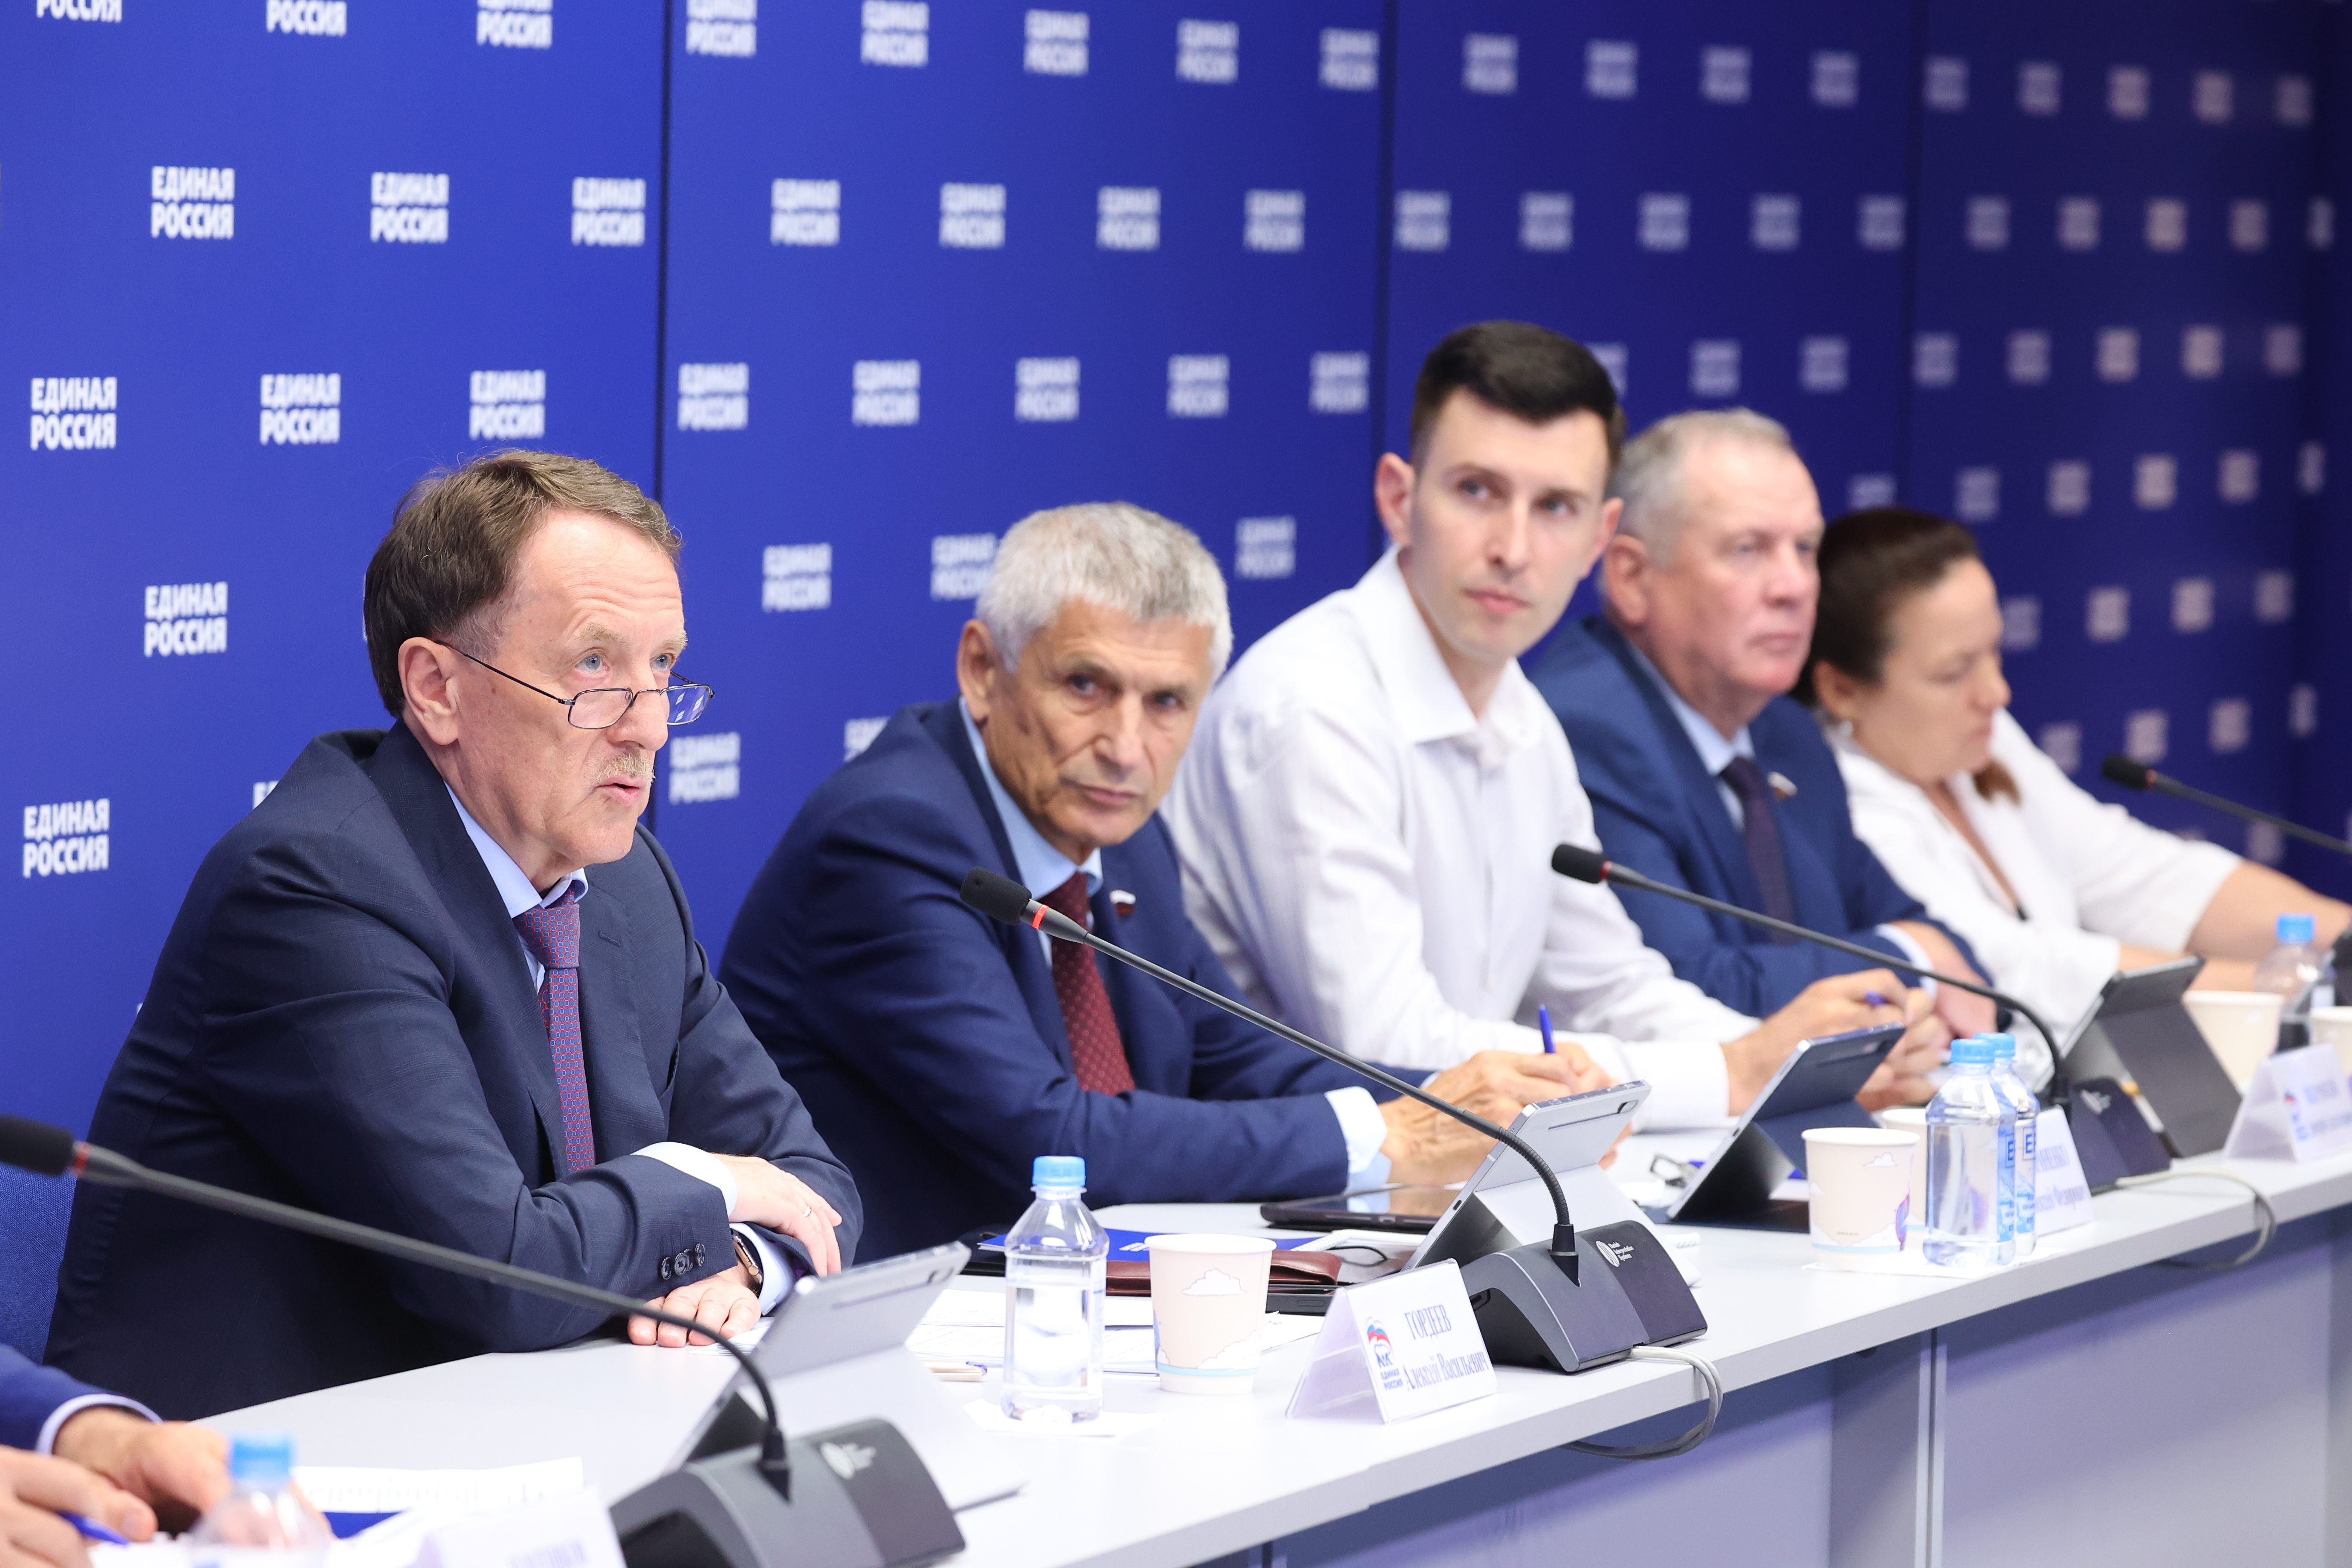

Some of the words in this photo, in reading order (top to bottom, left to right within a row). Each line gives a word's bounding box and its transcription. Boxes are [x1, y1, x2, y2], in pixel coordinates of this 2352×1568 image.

[266, 0, 346, 36] РОССИЯ
[152, 166, 234, 201] ЕДИНАЯ
[371, 172, 449, 206] ЕДИНАЯ
[151, 202, 234, 239] РОССИЯ
[371, 207, 448, 242] РОССИЯ
[31, 377, 117, 412] ЕДИНАЯ
[261, 374, 340, 407] ЕДИНАЯ
[31, 413, 116, 450] РОССИЯ
[260, 408, 340, 444] РОССИЯ
[145, 582, 227, 619] ЕДИНАЯ
[144, 617, 227, 656] РОССИЯ
[24, 799, 110, 839] ЕДИНАЯ
[23, 835, 109, 877] РОССИЯ
[1404, 1305, 1452, 1341] ГОРДЕЕВ
[1381, 1368, 1400, 1380] ЕДИНАЯ
[1384, 1378, 1403, 1390] РОССИЯ
[1403, 1355, 1442, 1391] Алексей
[1437, 1351, 1489, 1380] Васильевич
